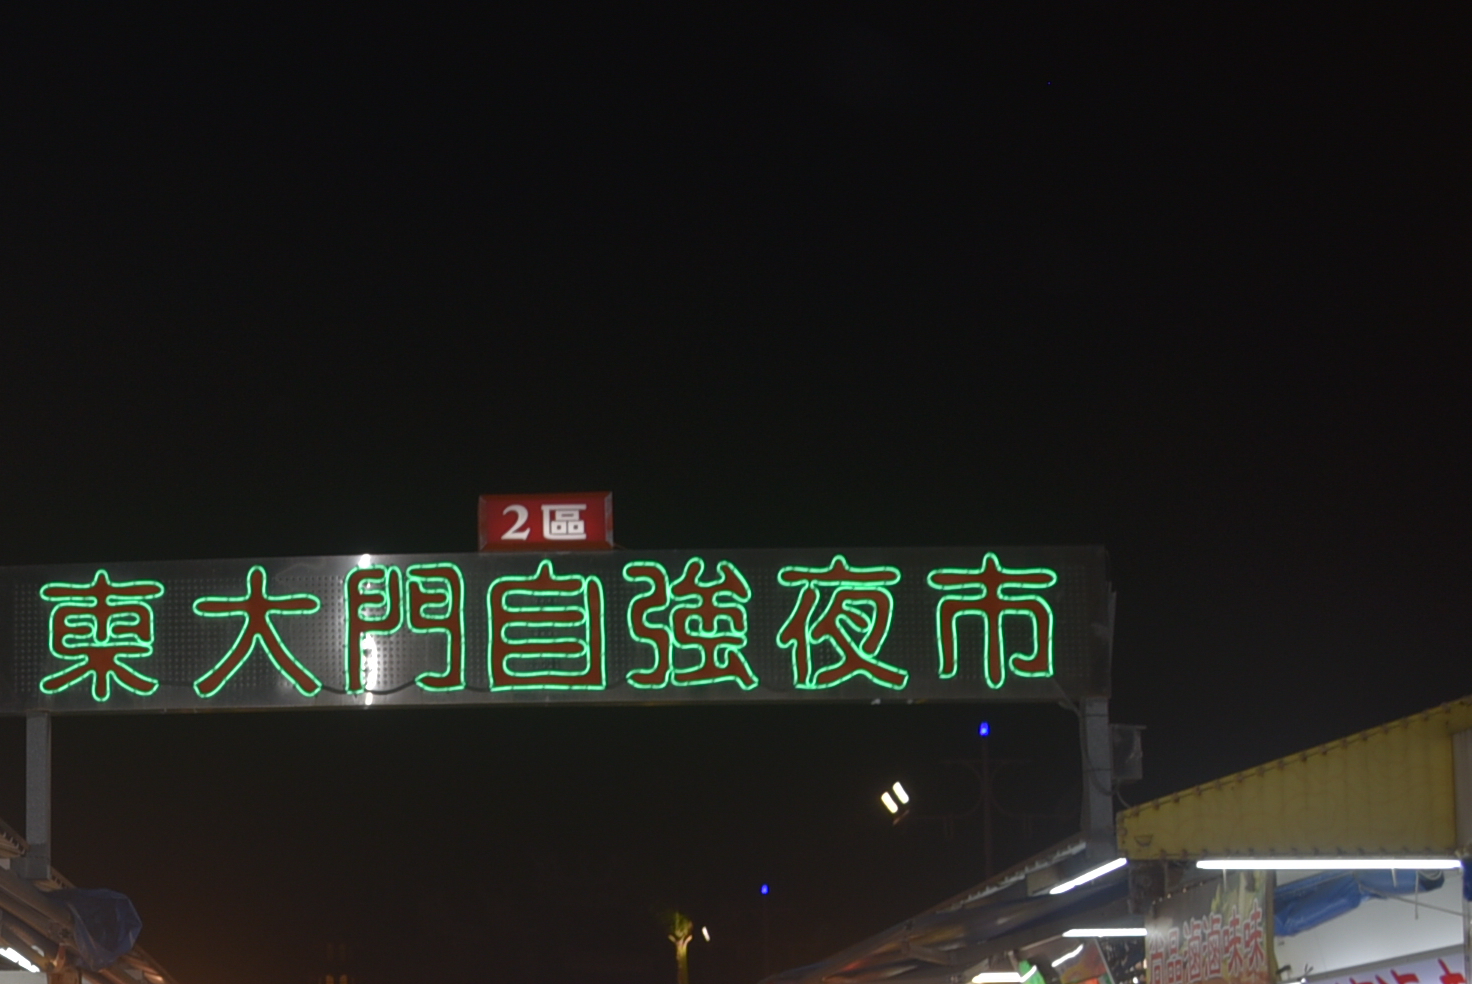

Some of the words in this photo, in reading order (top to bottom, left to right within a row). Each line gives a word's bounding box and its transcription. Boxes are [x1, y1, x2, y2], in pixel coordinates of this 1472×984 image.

[501, 504, 587, 540] 2區
[39, 552, 1057, 701] 東大門自強夜市
